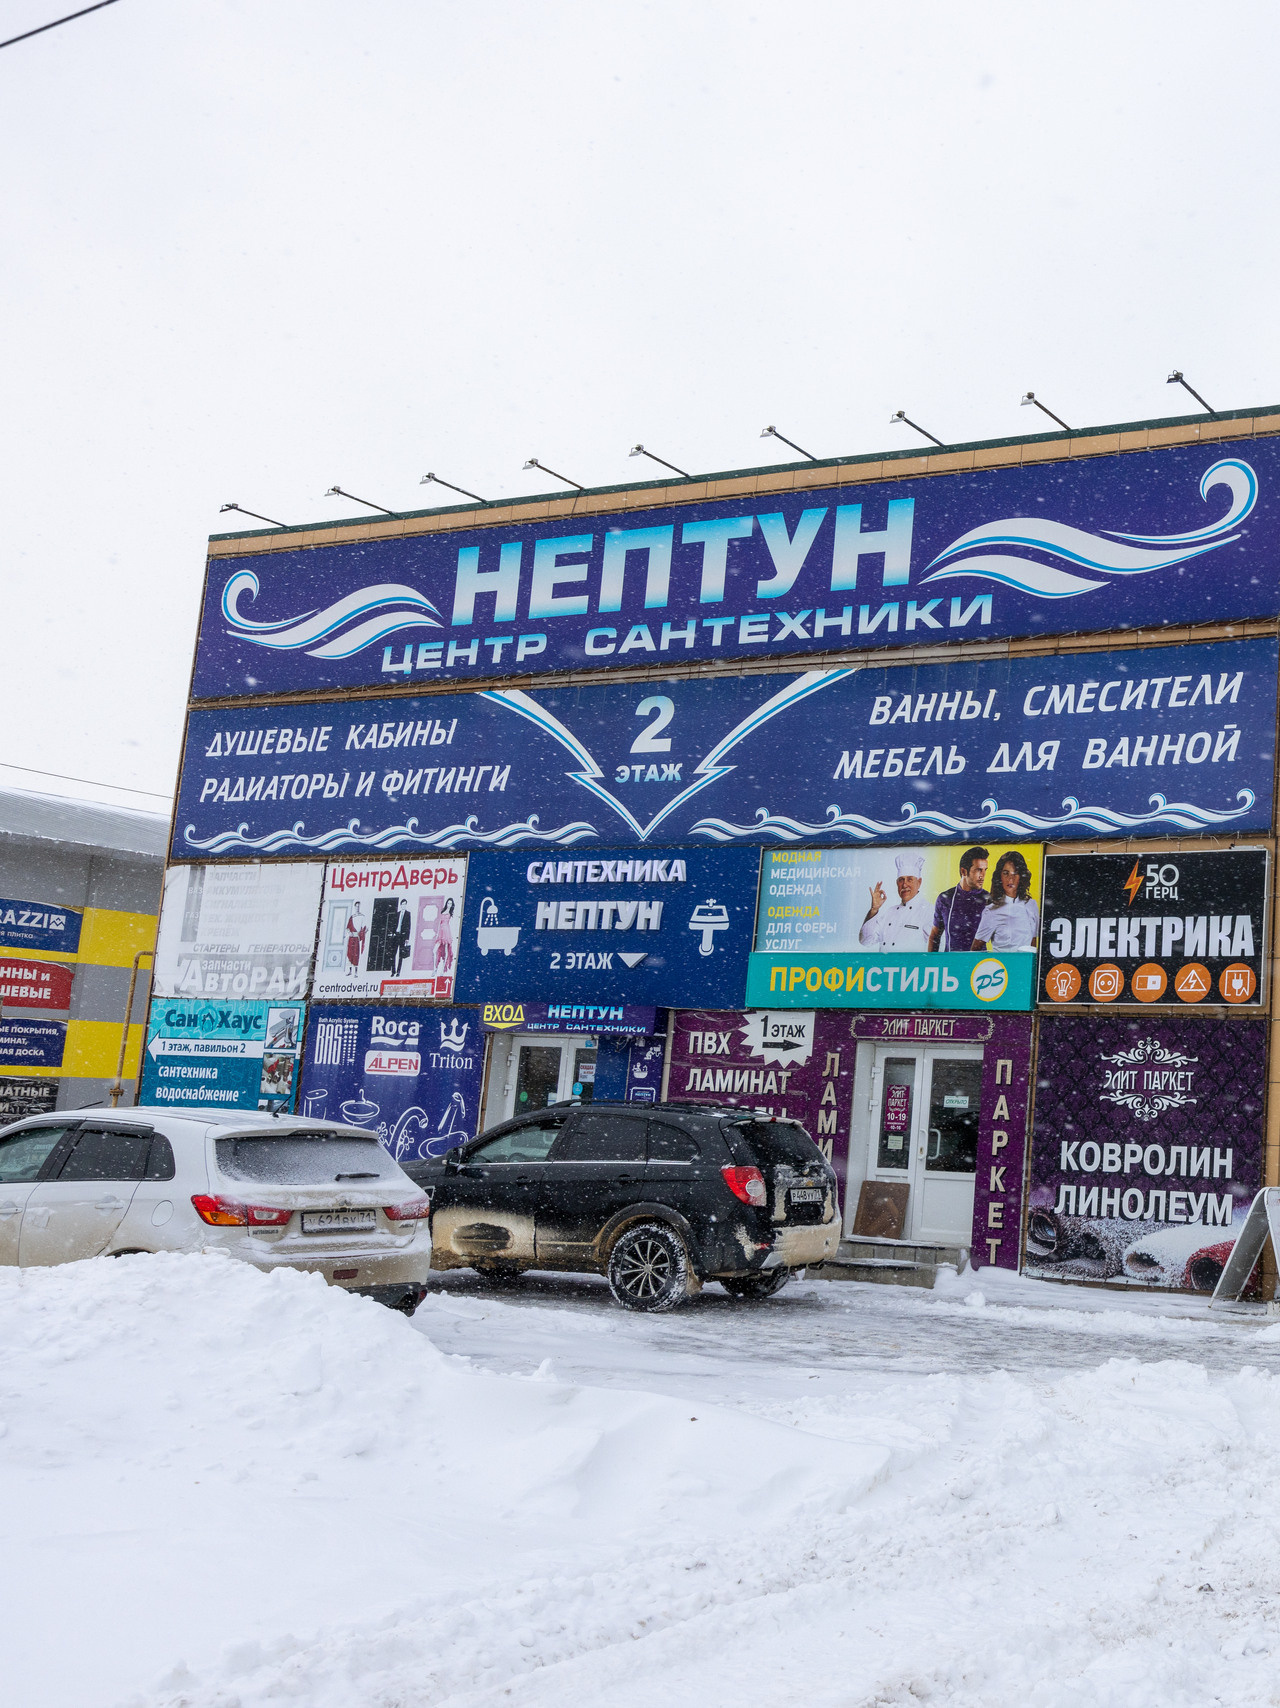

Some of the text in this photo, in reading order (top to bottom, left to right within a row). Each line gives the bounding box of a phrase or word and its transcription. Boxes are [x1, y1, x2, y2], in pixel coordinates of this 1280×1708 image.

[451, 497, 915, 626] НЕПТУН
[380, 593, 993, 675] ЦЕНТР САНТЕХНИКИ
[869, 670, 1245, 727] ВАННЫ, СМЕСИТЕЛИ
[629, 695, 675, 754] 2
[205, 718, 458, 758] ДУШЕВЫЕ КАБИНЫ
[832, 724, 1242, 780] МЕБЕЛЬ ДЛЯ ВАННОЙ
[614, 762, 683, 784] ЭТАЖ
[199, 765, 512, 804] РАДИАТОРЫ И ФИТИНГИ
[772, 850, 822, 863] МОДНАЯ
[331, 865, 459, 892] ЦентрДверь
[526, 859, 687, 884] САНТЕХНИКА
[771, 866, 861, 880] МЕДИЦИНСКАЯ
[1145, 864, 1180, 887] 50
[769, 884, 822, 896] ОДЕЖДА
[1145, 887, 1179, 901] ГЕРЦ
[535, 901, 664, 931] НЕПТУН
[767, 906, 820, 918] ОДЕЖДА
[766, 922, 837, 935] ДЛЯ СФЕРЫ
[1050, 915, 1255, 958] ЭЛЕКТРИКА
[193, 943, 241, 953] СТАРТЕРЫ
[247, 943, 312, 953] ГЕНЕРАТОРЫ
[765, 939, 802, 950] УСЛУГ
[202, 959, 251, 972] запчасти
[550, 952, 613, 970] 2 ЭТАЖ
[319, 982, 379, 993] centrodveri.ru
[769, 966, 960, 993] ПРОФИСТИЛЬ
[483, 1004, 525, 1022] ВХОД
[547, 1005, 624, 1021] НЕПТУН
[371, 1016, 420, 1036] Roca
[526, 1023, 646, 1033] ЦЕНТР САНТЕХНИКИ
[760, 1015, 806, 1039] 1 ЭТАЖ
[881, 1018, 956, 1037] ЭЛИТ ПАРКЕТ
[161, 1041, 246, 1053] 1 этаж, павильон 2
[688, 1031, 732, 1055] ПВХ
[368, 1057, 419, 1071] ALPEN
[429, 1053, 473, 1070] Triton
[158, 1065, 218, 1079] сантехника
[685, 1069, 792, 1095] ЛАМИНАТ
[1103, 1070, 1195, 1091] ЭЛИТ ПАРКЕТ
[155, 1085, 239, 1102] водоснабжение
[985, 1059, 1014, 1265] ПАРКЕТ
[1060, 1141, 1233, 1179] КОВРОЛИН
[1054, 1185, 1233, 1225] ЛИНОЛЕУМ
